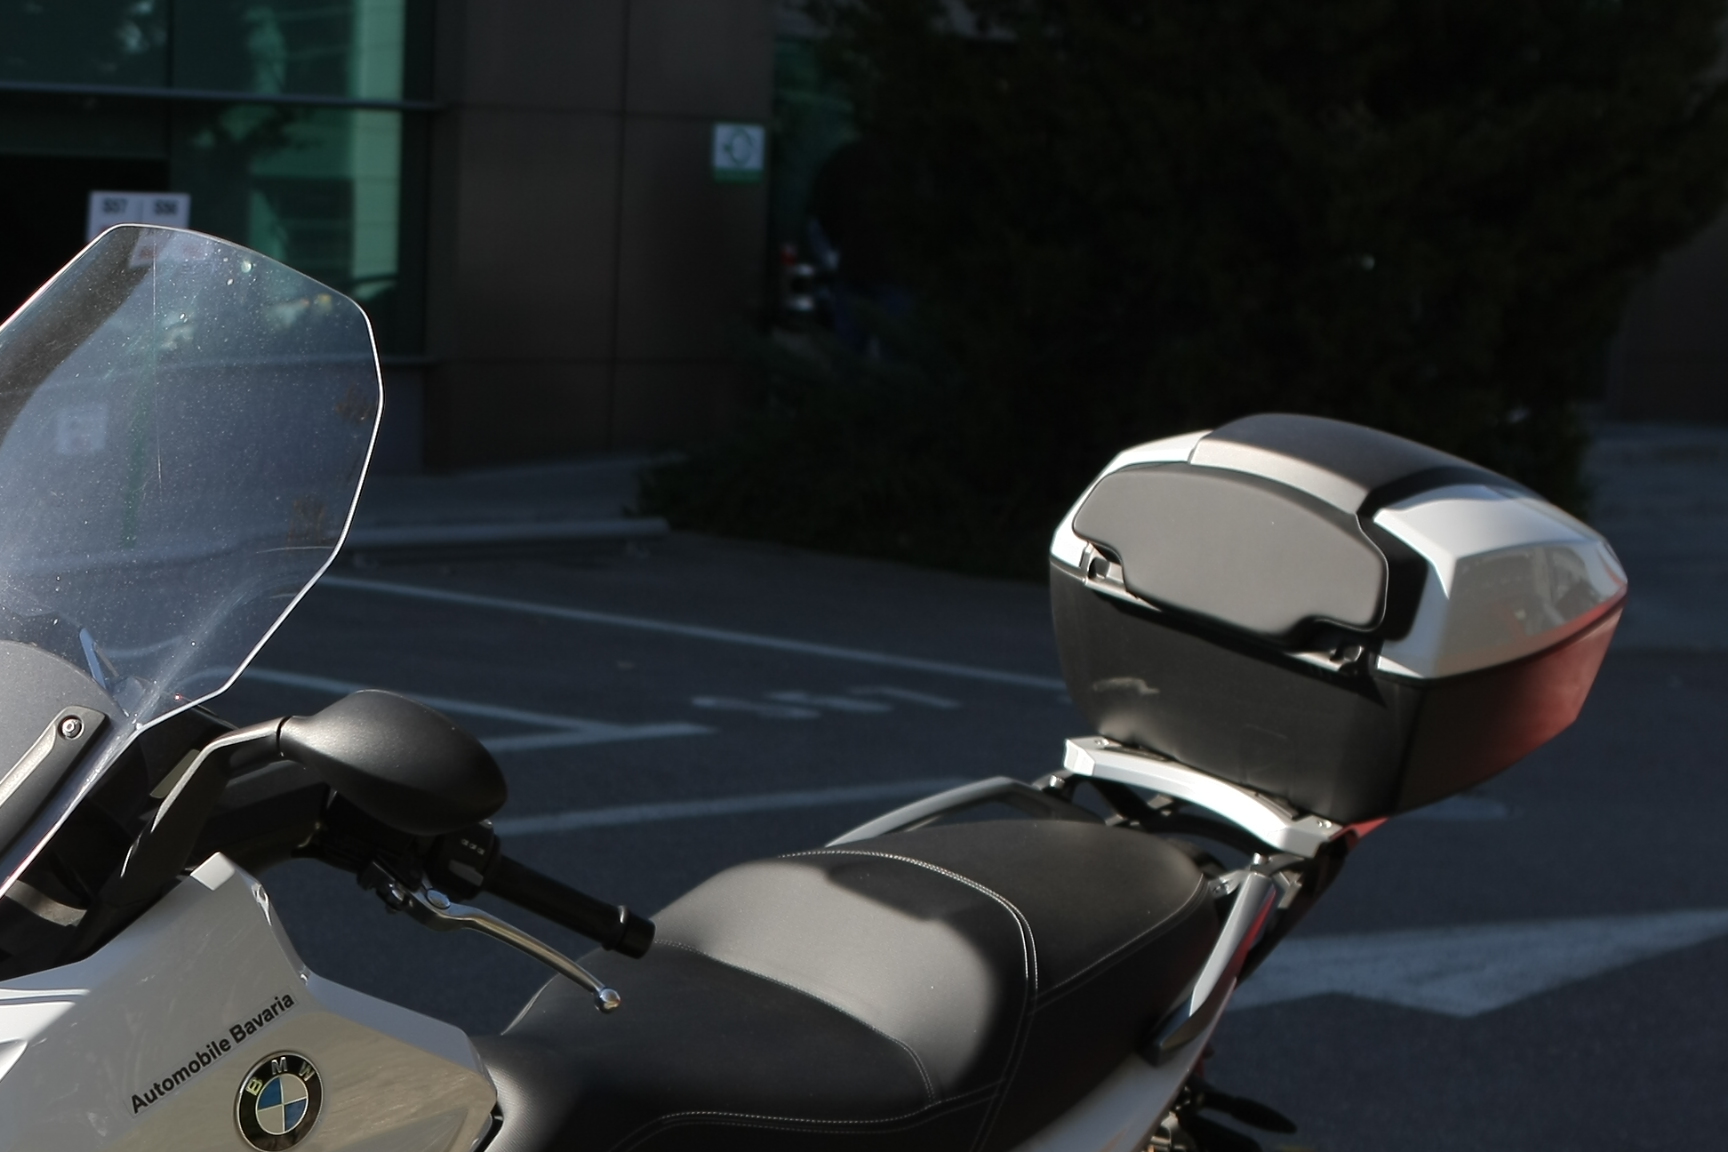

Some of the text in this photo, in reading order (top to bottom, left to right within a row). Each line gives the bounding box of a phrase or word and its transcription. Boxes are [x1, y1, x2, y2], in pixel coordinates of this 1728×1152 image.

[130, 992, 295, 1115] Automobile Bavaria
[246, 1055, 317, 1096] BMW
